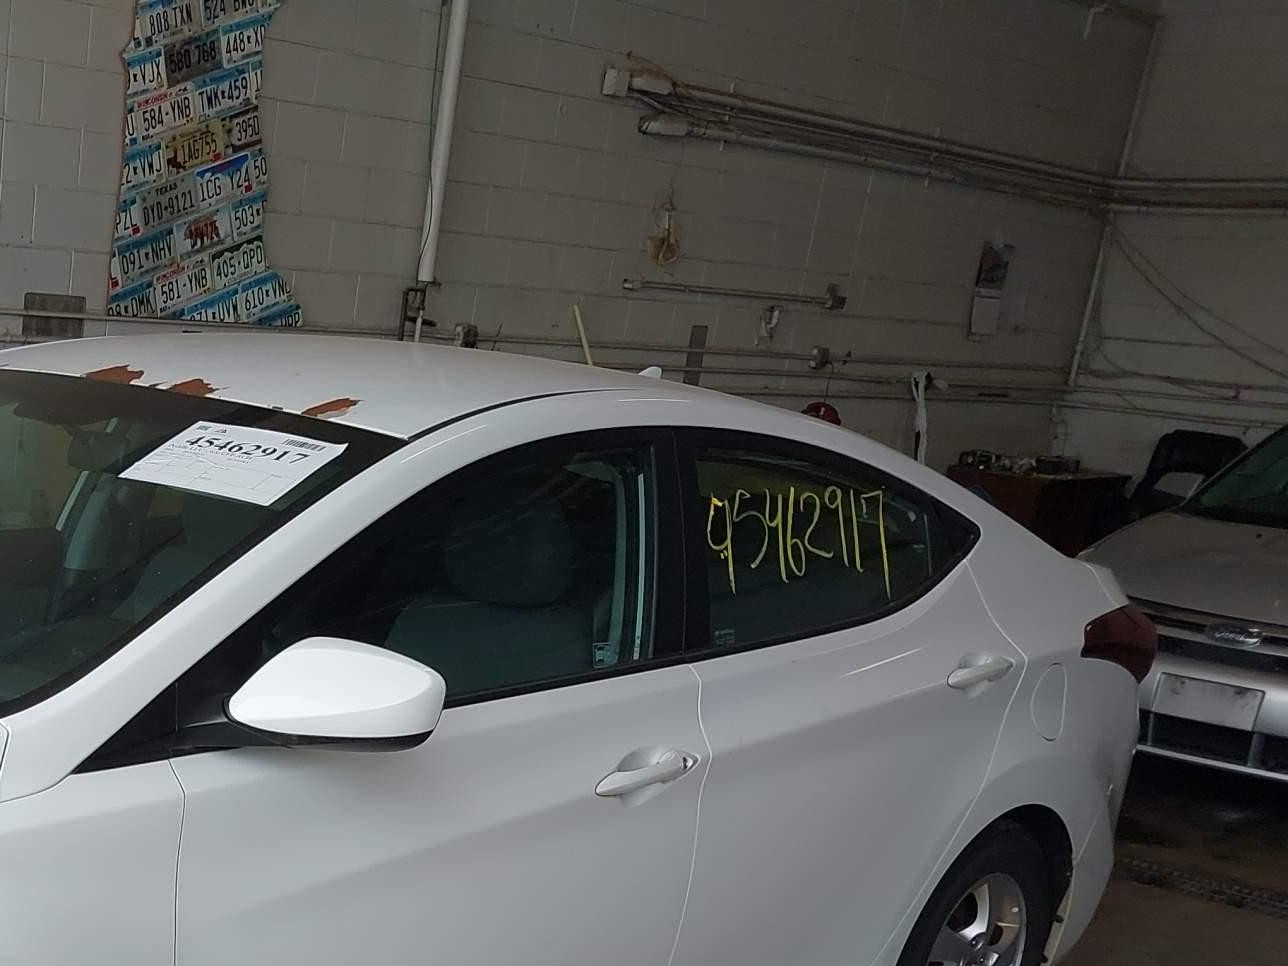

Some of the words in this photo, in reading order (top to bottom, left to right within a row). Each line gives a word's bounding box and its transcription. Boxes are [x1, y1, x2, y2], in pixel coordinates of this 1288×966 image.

[149, 11, 170, 36] 808
[173, 4, 193, 28] TXN
[225, 31, 245, 57] 448
[198, 87, 222, 112] TWK
[227, 76, 248, 100] 459
[155, 183, 178, 196] TEXAS
[234, 206, 254, 230] 503
[122, 248, 145, 274] 091
[151, 237, 172, 264] NHV
[161, 268, 208, 305] 581-YNB
[245, 287, 264, 311] 610
[185, 436, 311, 464] 45462917
